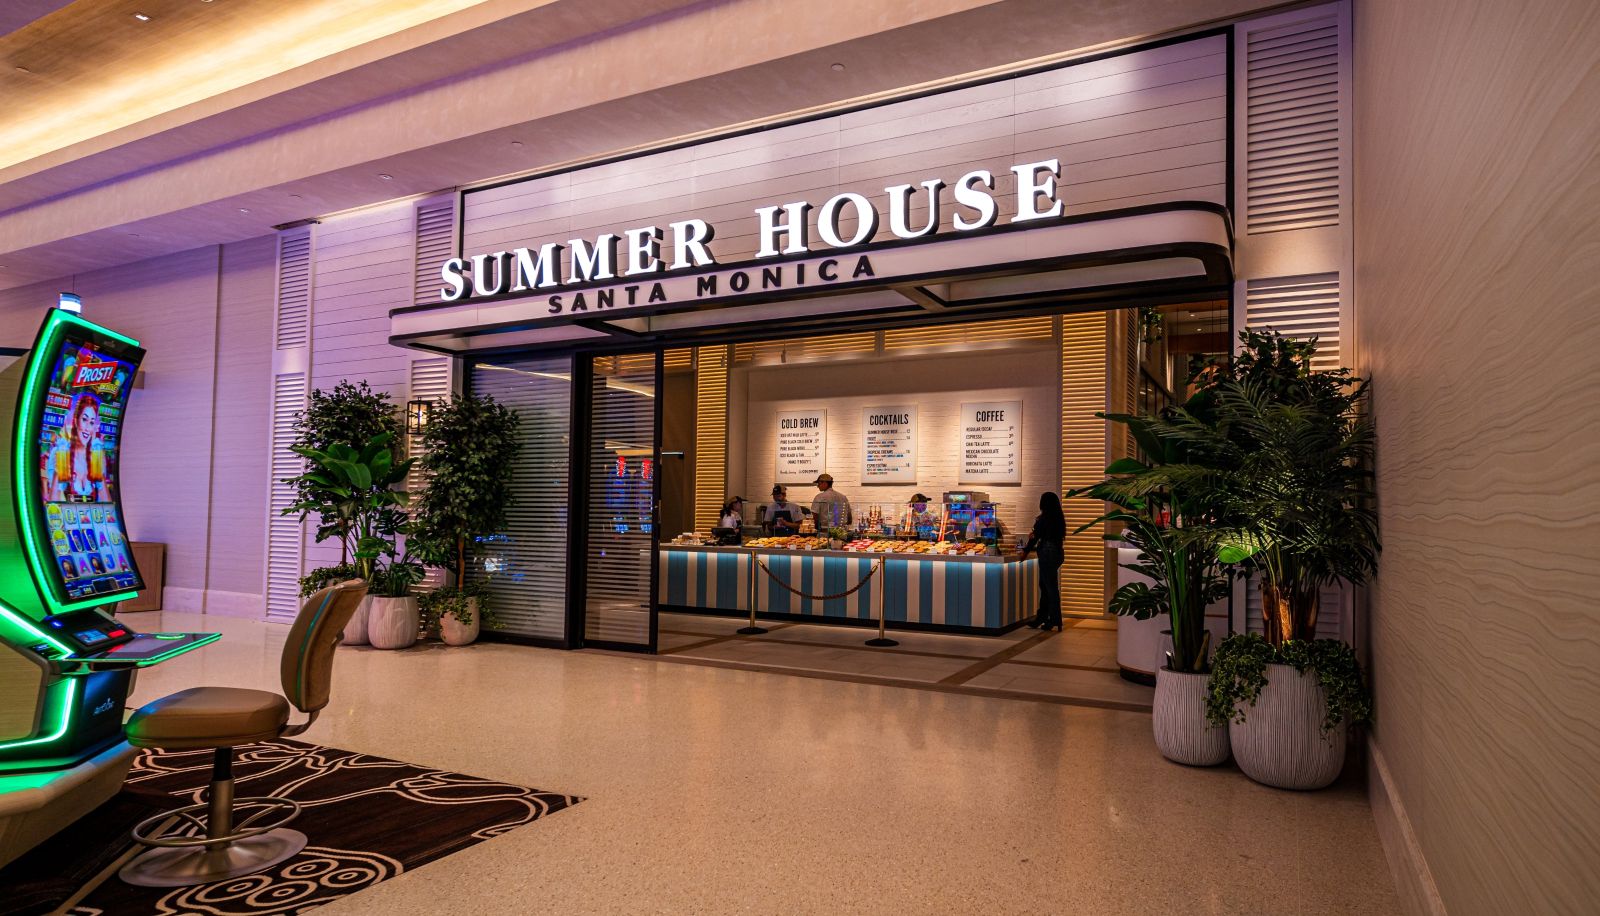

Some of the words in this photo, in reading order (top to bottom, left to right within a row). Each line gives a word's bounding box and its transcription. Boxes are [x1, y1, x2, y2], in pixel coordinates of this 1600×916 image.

[441, 218, 716, 301] SUMMER
[755, 158, 1064, 258] HOUSE
[548, 282, 667, 313] SANTA
[696, 255, 875, 297] MONICA
[76, 366, 114, 384] PROST!
[782, 418, 798, 429] COLD
[800, 418, 819, 428] BREW
[870, 414, 909, 425] COCKTAILS
[976, 411, 1004, 422] COFFEE
